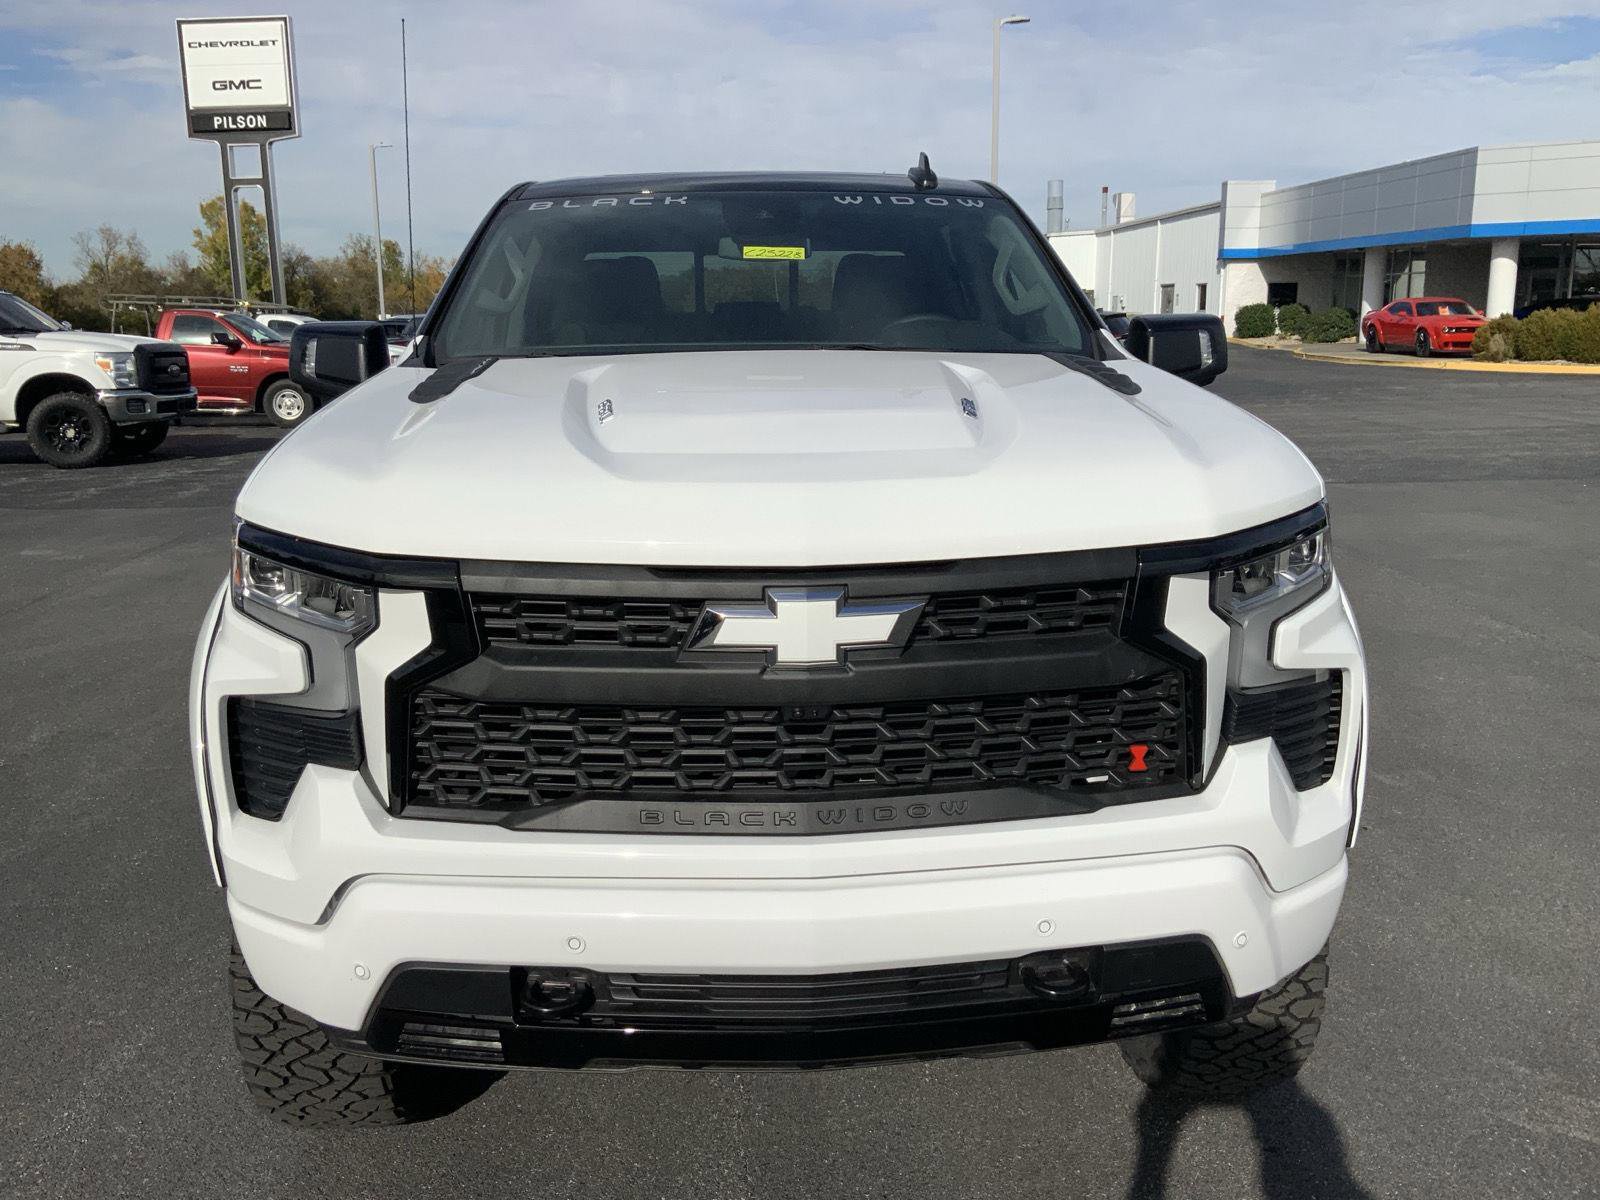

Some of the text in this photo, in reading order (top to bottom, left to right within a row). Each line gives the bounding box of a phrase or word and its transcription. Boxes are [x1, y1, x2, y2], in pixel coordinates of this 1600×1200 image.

[188, 40, 278, 48] CHEVROLET
[212, 79, 262, 91] GMC
[213, 115, 267, 129] PILSON
[528, 196, 984, 211] BLACK WIDOW
[639, 800, 969, 826] BLACK WIDOW
